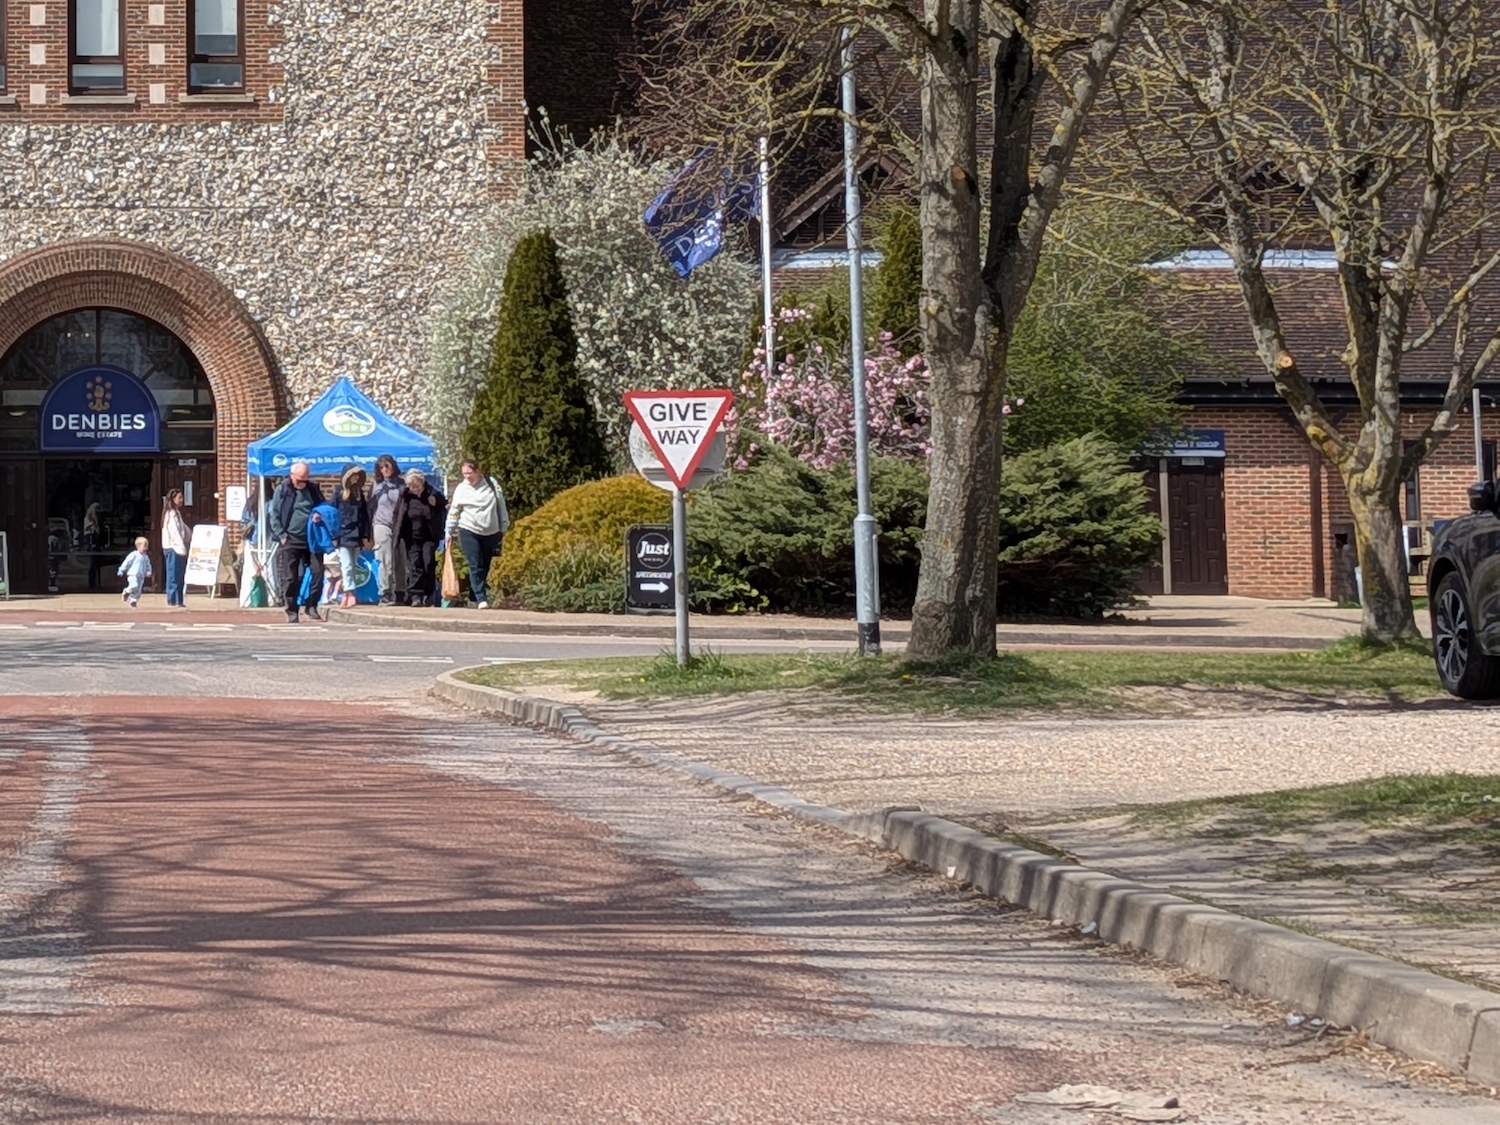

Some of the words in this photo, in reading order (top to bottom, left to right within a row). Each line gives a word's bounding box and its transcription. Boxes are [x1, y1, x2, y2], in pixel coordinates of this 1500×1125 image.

[649, 402, 708, 422] GIVE
[52, 414, 146, 430] DENBIES
[657, 429, 701, 445] WAY
[637, 540, 670, 559] Just
